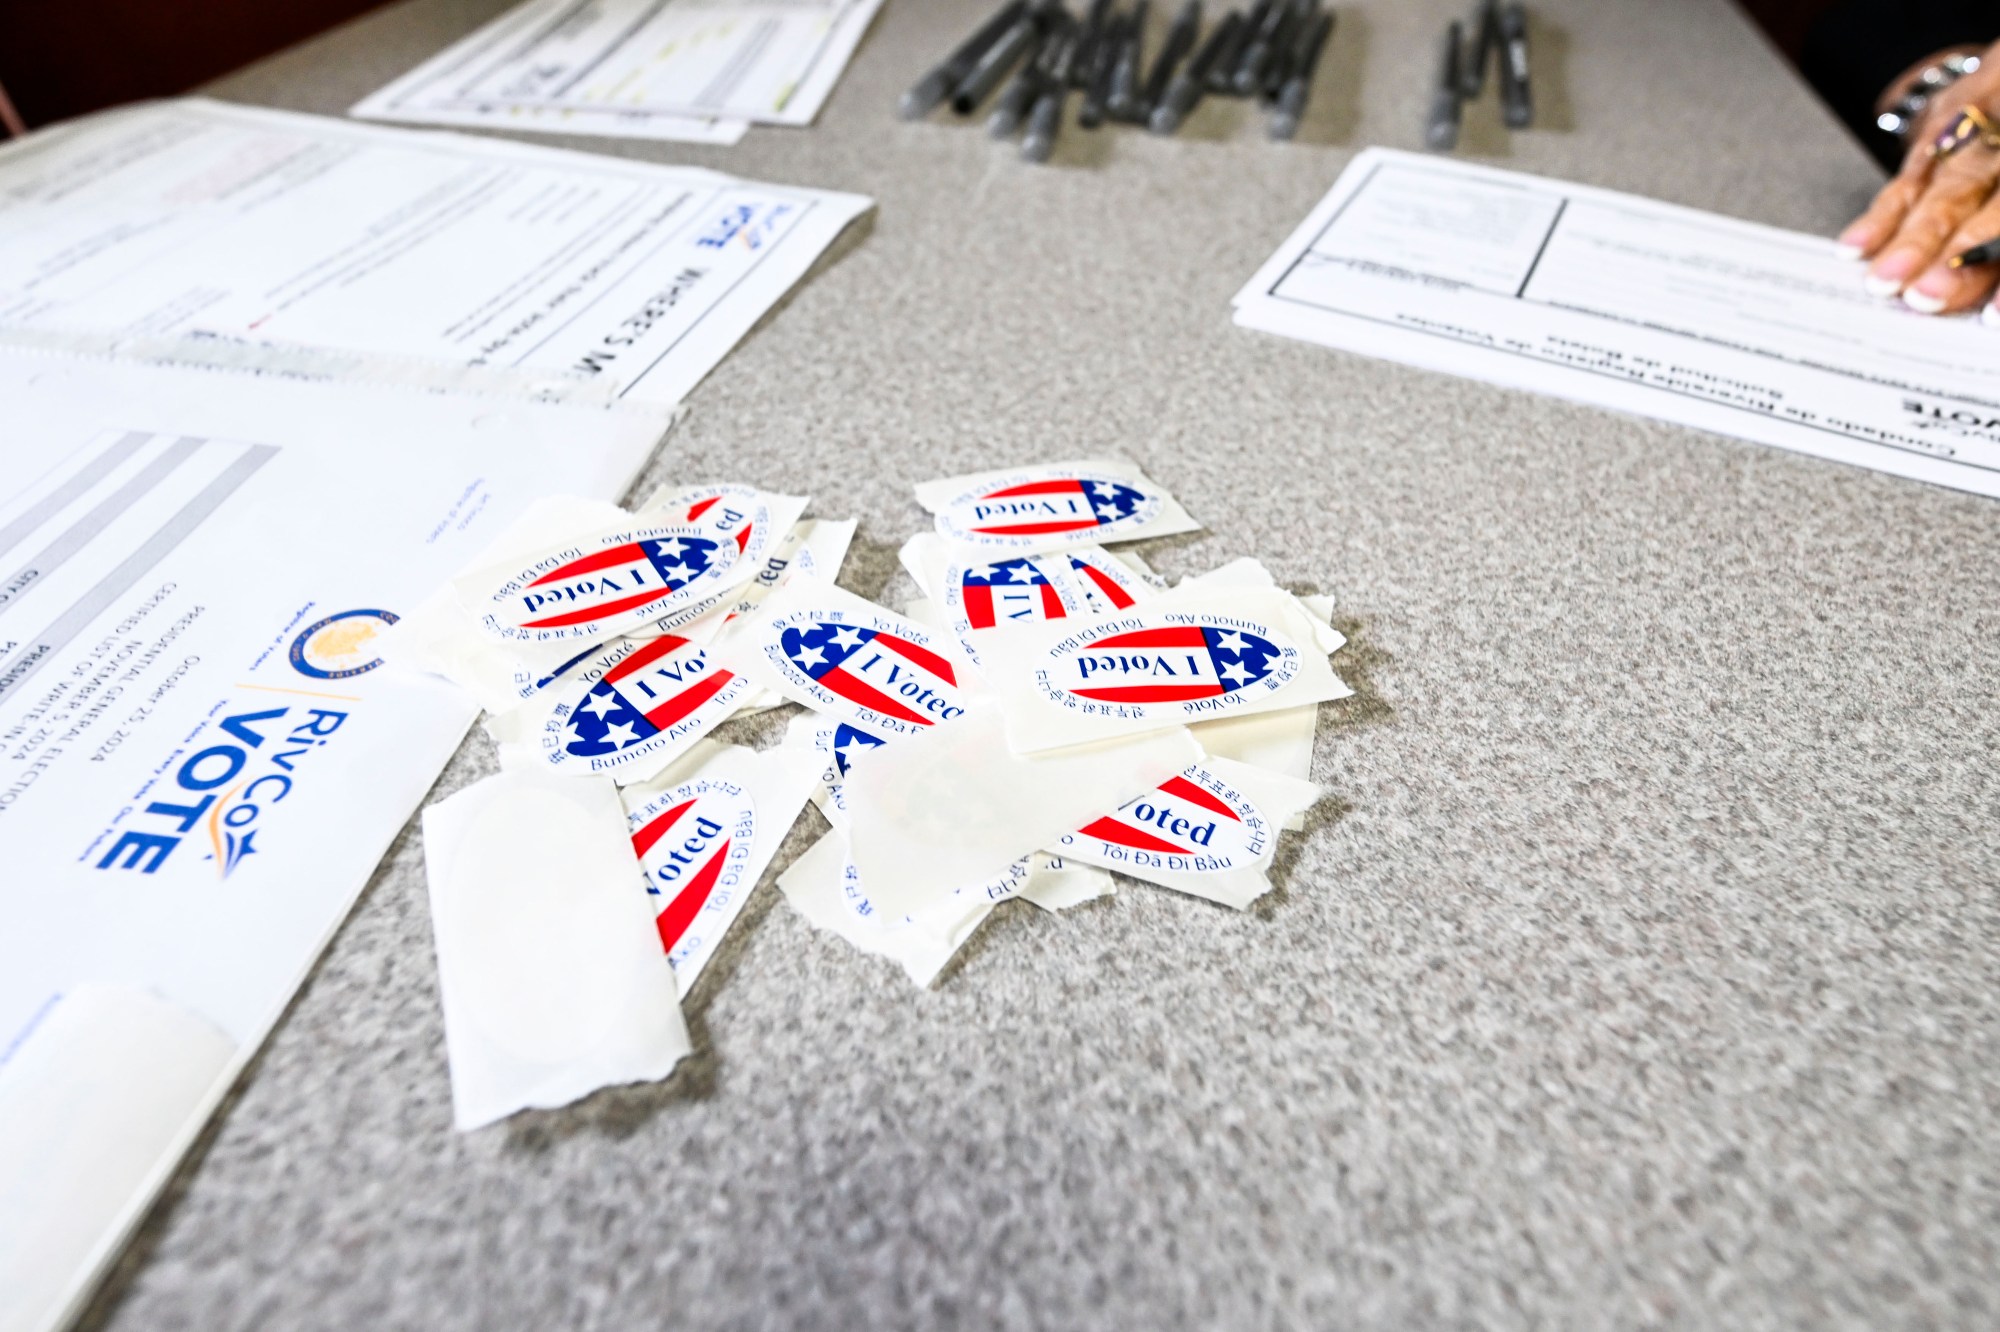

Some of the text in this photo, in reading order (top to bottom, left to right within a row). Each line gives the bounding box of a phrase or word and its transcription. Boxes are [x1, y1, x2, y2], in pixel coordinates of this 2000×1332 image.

[572, 351, 617, 377] M
[1653, 373, 1774, 411] Riverside
[1786, 407, 1816, 420] de
[1827, 418, 1956, 456] Condado
[974, 499, 1079, 521] I Voted
[115, 582, 177, 634] CERTIFIED
[523, 568, 646, 613] I Voted
[873, 616, 930, 646] Yo Voté
[1165, 613, 1267, 637] Bumoto Ako
[67, 639, 143, 710] NOVEMBER
[149, 655, 201, 703] October
[578, 667, 602, 684] Yo
[601, 640, 636, 669] Voté
[763, 643, 834, 705] Bumoto Ako
[859, 653, 885, 674] I
[1077, 654, 1201, 680] I Voted
[635, 680, 658, 699] I
[1183, 692, 1248, 714] Yo Voté
[0, 604, 205, 811] PRESIDENTIAL GENERAL ELECTIO
[854, 706, 878, 724] Tôi
[11, 728, 54, 760] 2024
[90, 729, 131, 762] 2024
[590, 717, 702, 772] Bumoto Ako
[224, 708, 349, 828] RivCo
[95, 706, 292, 875] VOTE
[1117, 795, 1217, 848] oted
[1101, 842, 1233, 872] Tôi Đã Đi Bầu
